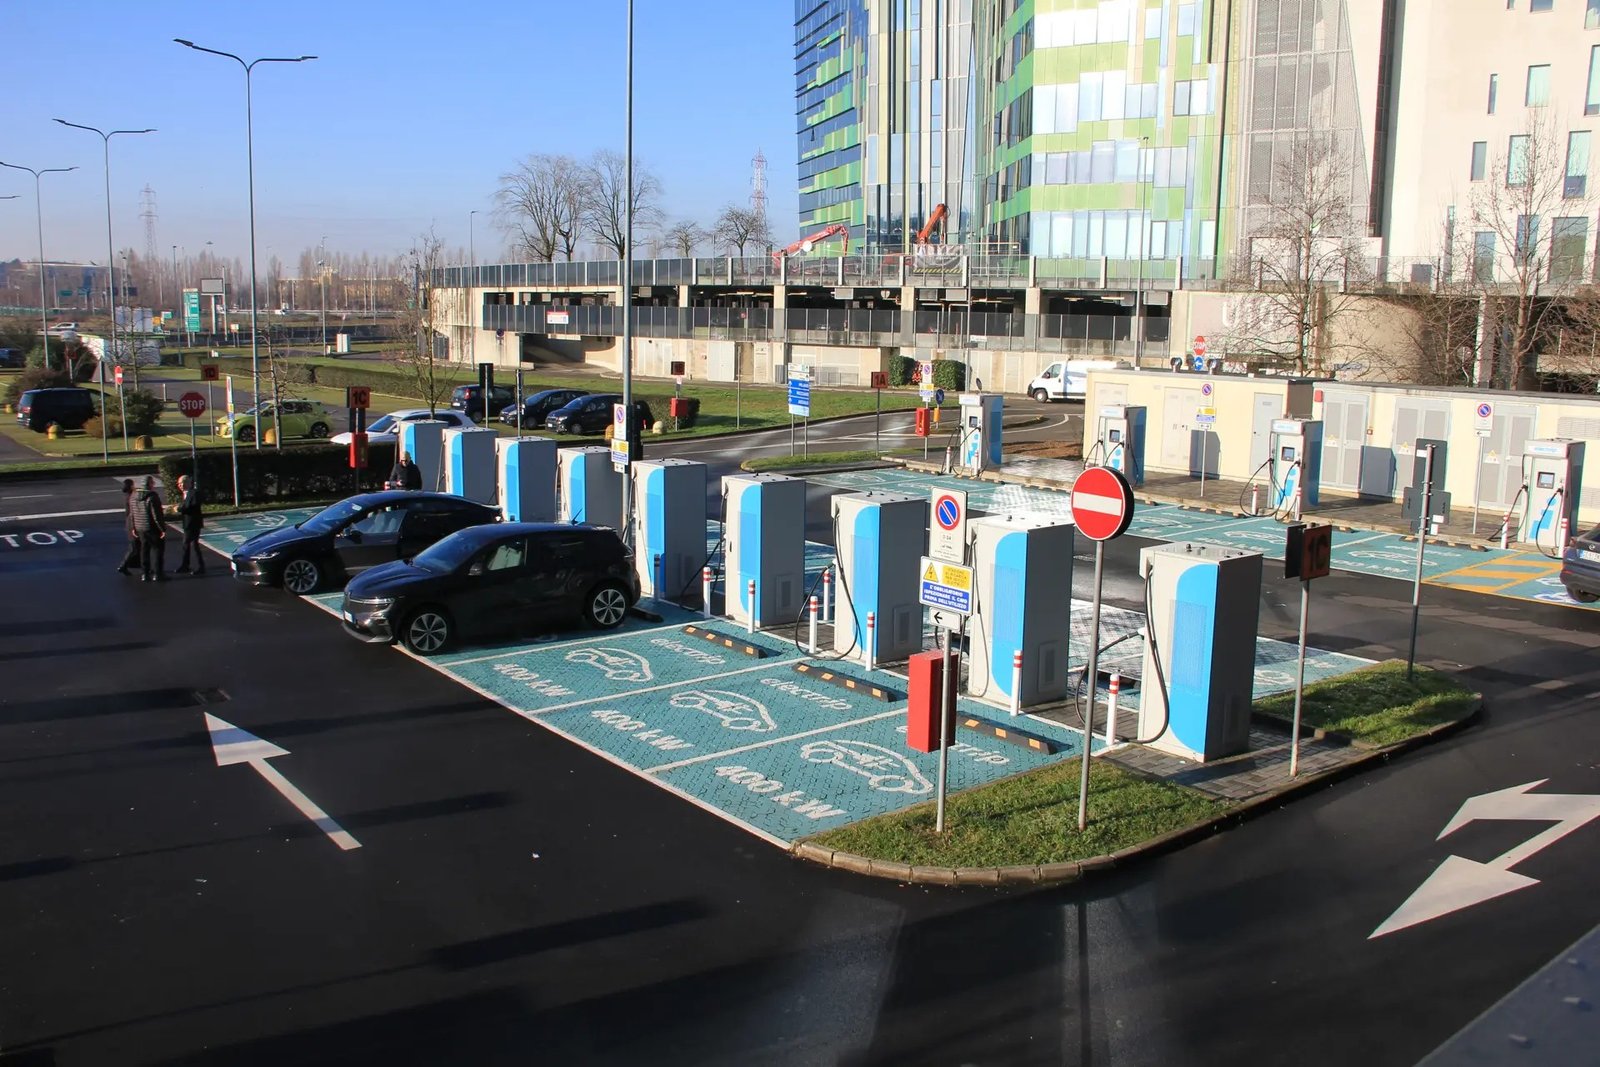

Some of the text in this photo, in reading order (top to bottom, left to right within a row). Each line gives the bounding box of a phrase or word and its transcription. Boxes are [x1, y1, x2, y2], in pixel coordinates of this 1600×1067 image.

[875, 374, 887, 386] 1A
[181, 400, 205, 410] STOP
[352, 391, 367, 405] 1C
[1307, 533, 1329, 573] 1C
[924, 594, 937, 602] PRIMA
[651, 638, 726, 665] electrip
[492, 663, 576, 697] 400 kW
[760, 678, 853, 710] electrip
[591, 709, 695, 750] 400 kW
[714, 765, 848, 819] 400 kW
